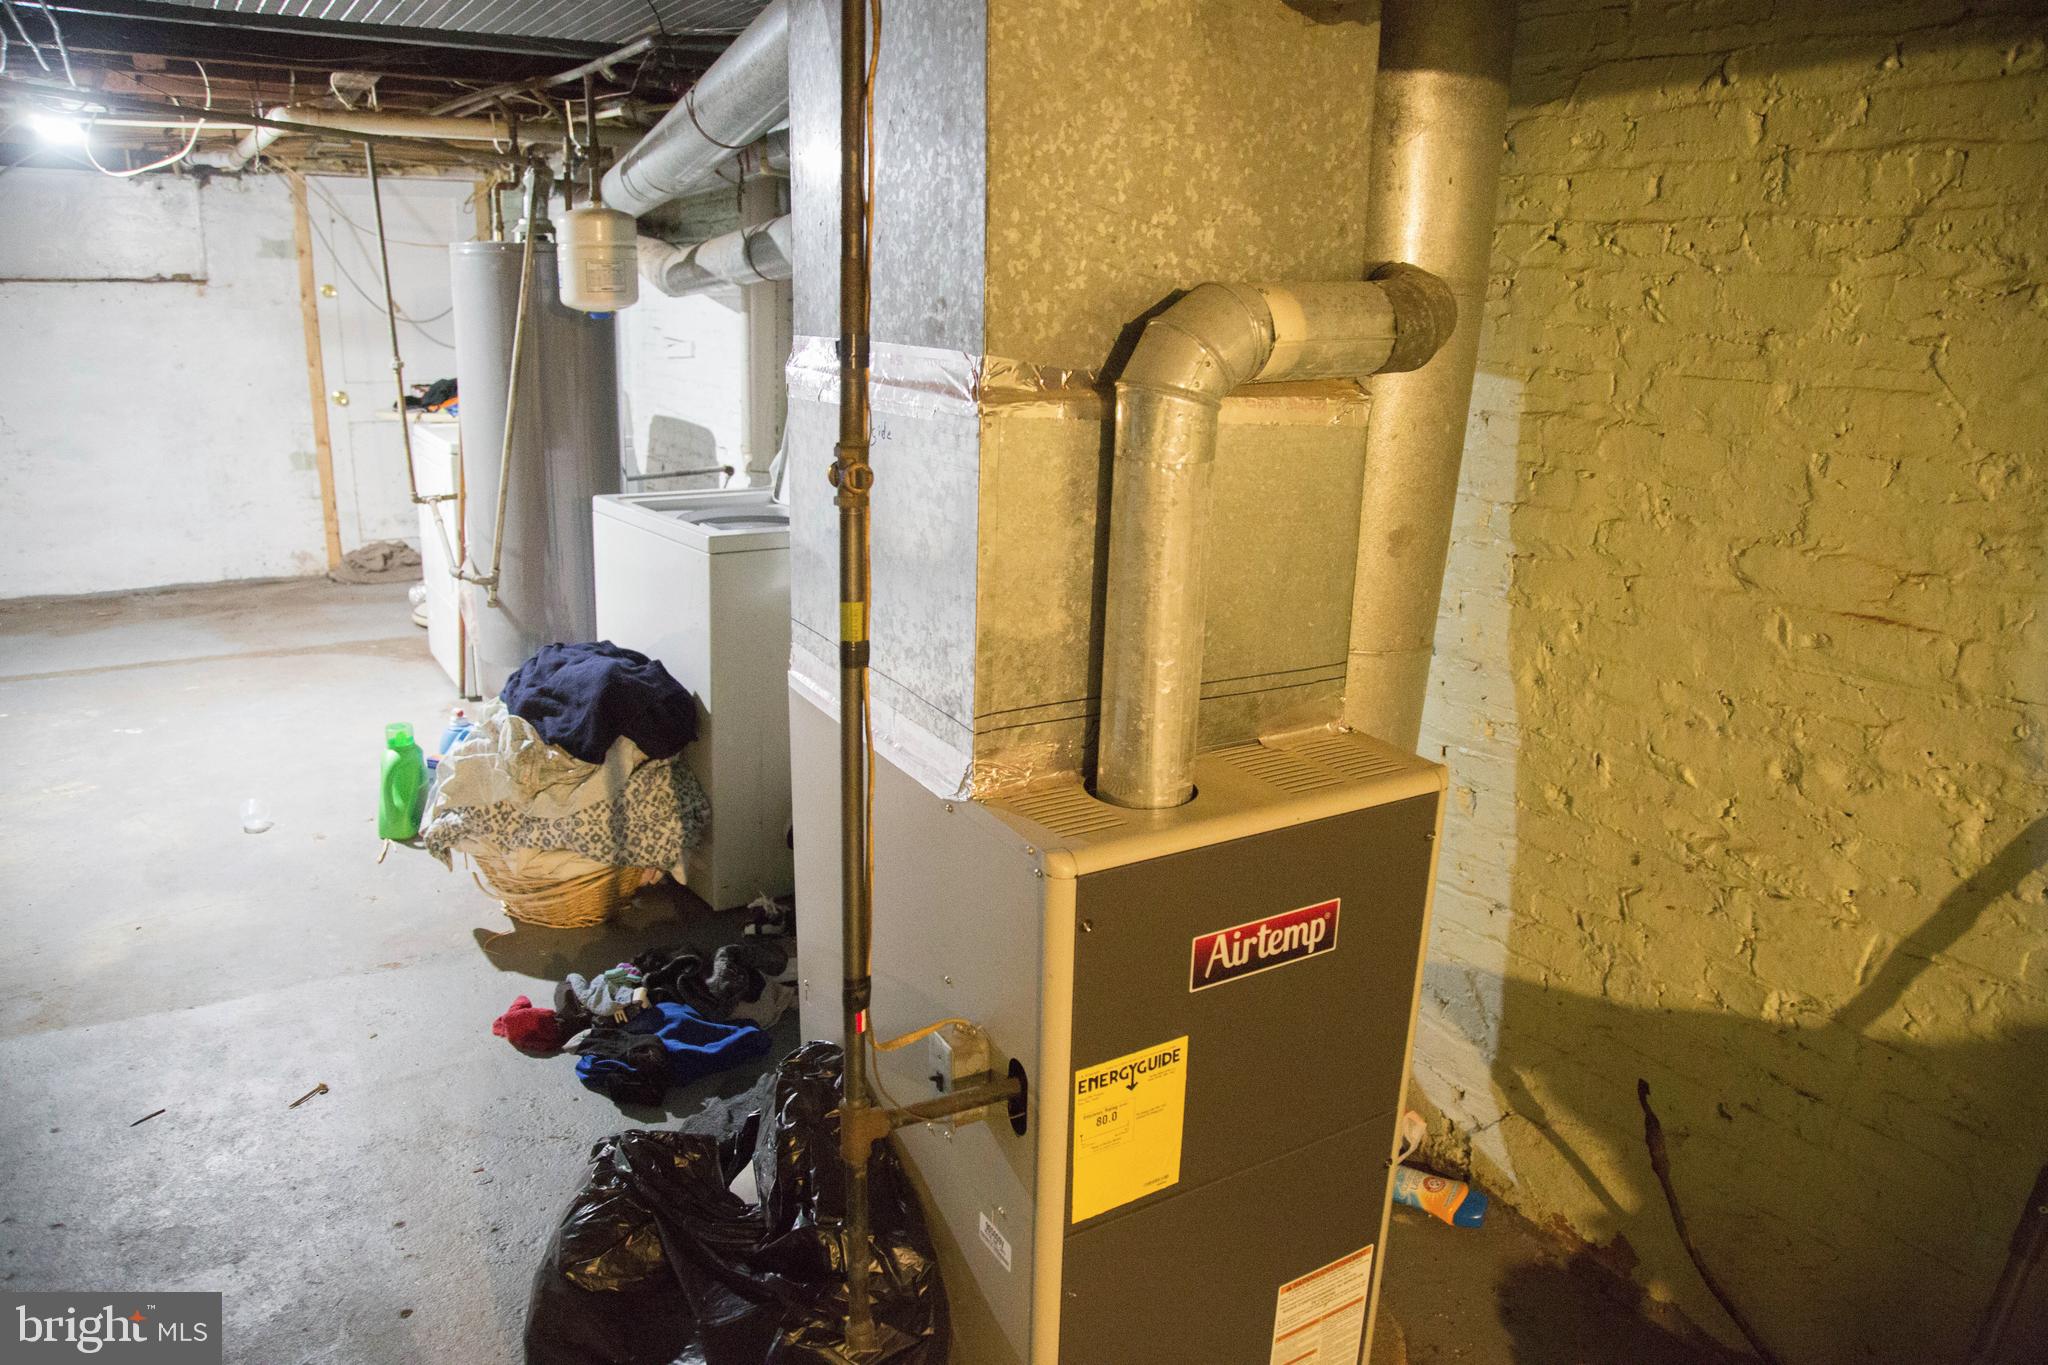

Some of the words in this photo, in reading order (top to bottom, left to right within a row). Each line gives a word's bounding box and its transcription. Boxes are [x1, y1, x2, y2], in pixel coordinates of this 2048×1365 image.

[1205, 917, 1326, 979] Airtemp
[1078, 1048, 1181, 1095] ENERGYGUIDE
[1096, 1111, 1118, 1127] 80.0
